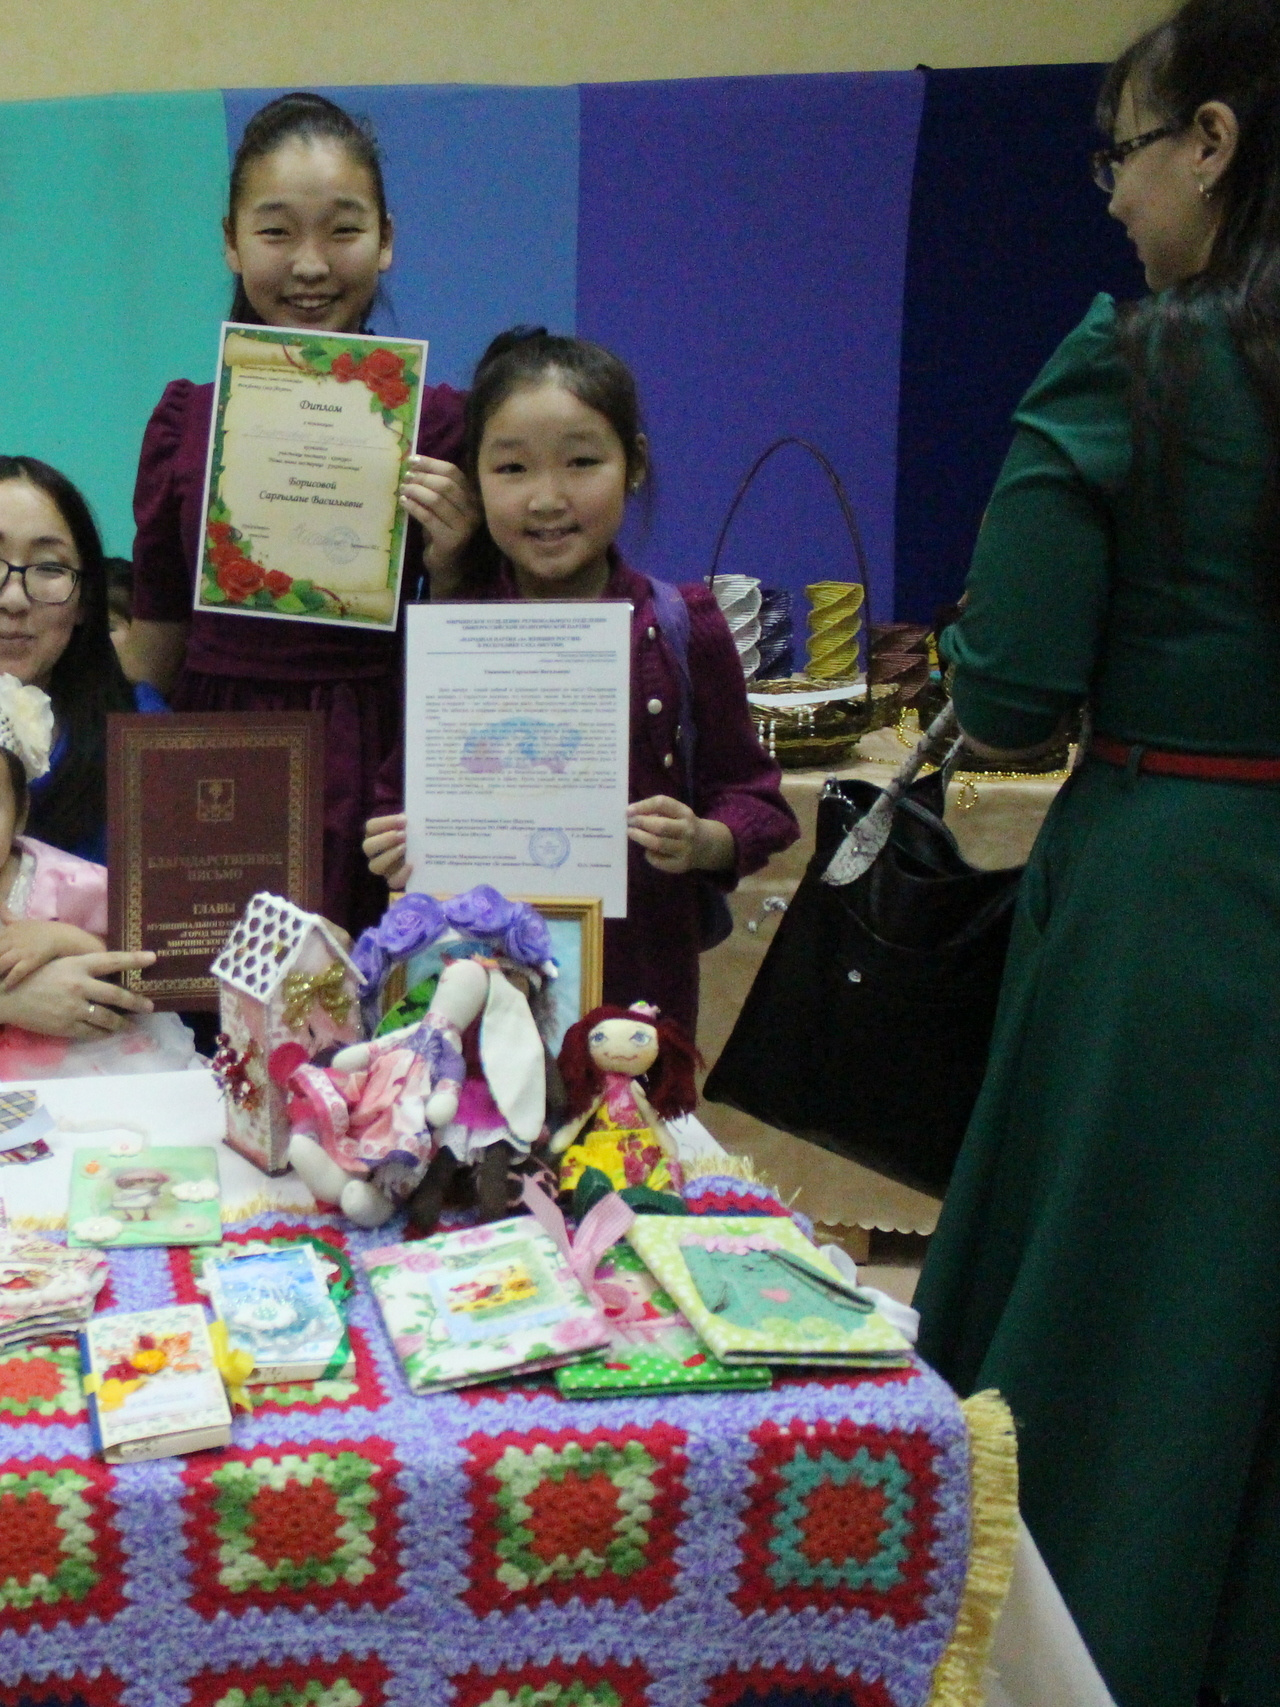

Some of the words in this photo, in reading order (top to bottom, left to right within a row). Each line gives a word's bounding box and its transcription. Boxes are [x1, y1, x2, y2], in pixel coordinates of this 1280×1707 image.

[299, 400, 342, 413] Диплом
[288, 477, 337, 490] Борисовой
[188, 869, 243, 881] ПИСЬМО
[193, 903, 236, 914] ГЛАВЫ
